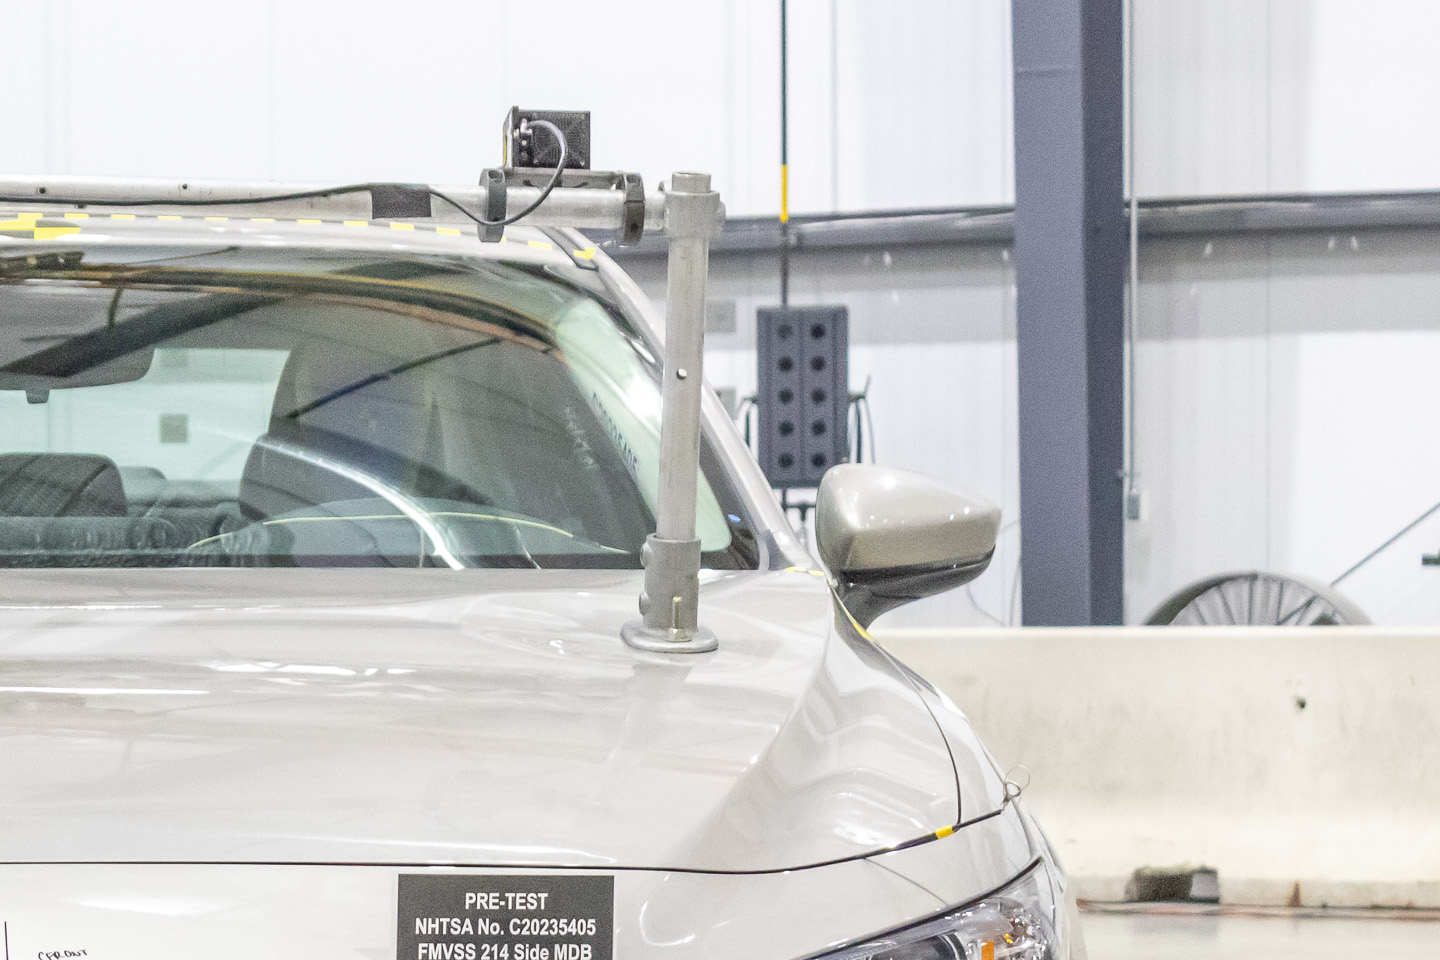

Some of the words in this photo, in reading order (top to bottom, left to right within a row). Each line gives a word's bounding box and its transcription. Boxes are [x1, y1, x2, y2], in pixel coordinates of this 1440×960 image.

[465, 893, 548, 909] PRE-TEST
[415, 918, 473, 935] NHTSA
[478, 918, 504, 935] No.
[509, 919, 596, 935] C20235405
[418, 944, 476, 960] FMVSS
[480, 944, 509, 960] 214
[514, 944, 549, 960] Side
[554, 944, 592, 960] MDB
